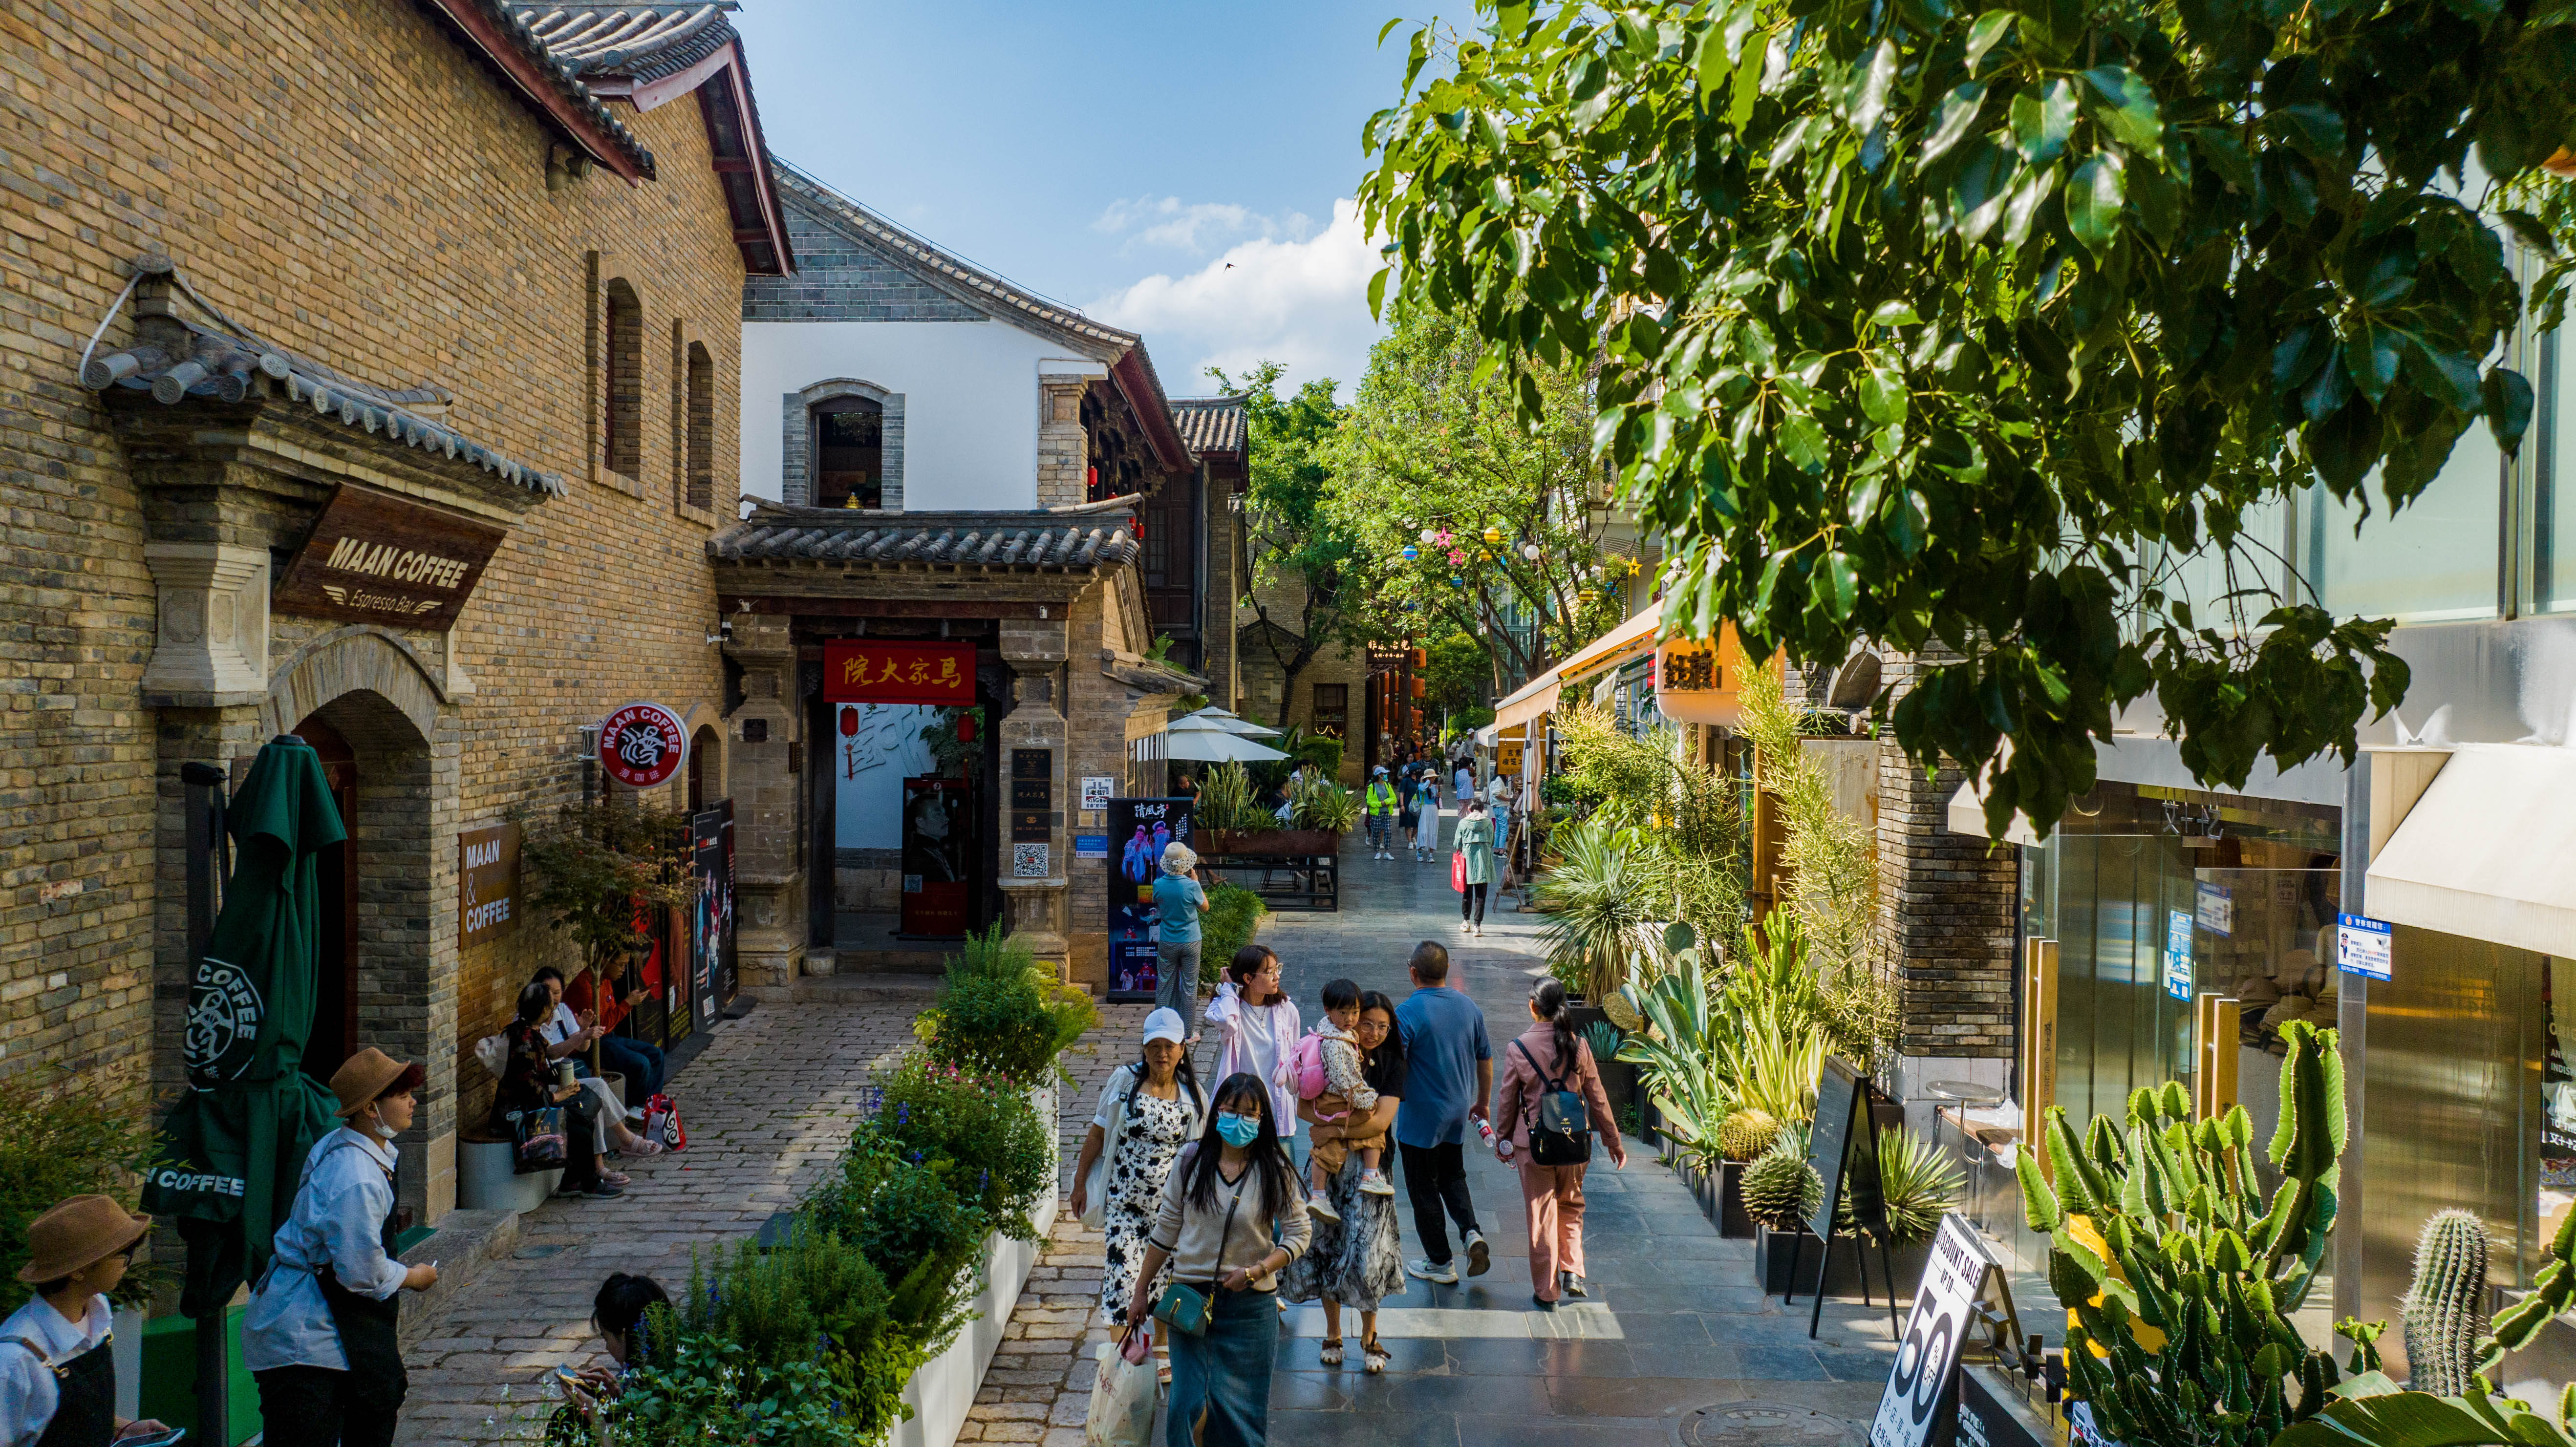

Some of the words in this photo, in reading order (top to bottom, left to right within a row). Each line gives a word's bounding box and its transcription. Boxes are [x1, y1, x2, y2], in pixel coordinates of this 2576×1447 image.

[326, 536, 400, 576] MAAN
[393, 551, 469, 589] COFFEE
[349, 589, 397, 613] Espresso
[397, 594, 415, 614] Bar
[603, 709, 636, 749] MAAN
[640, 708, 680, 755] COFFEE
[619, 767, 660, 783] 漫咖啡
[466, 839, 500, 870] MAAN
[466, 873, 476, 906] &
[465, 897, 510, 934] COFFEE
[196, 964, 258, 1042] COFFEE
[155, 1170, 245, 1196] COFFEE
[1936, 1224, 1964, 1274] DISCOUNT
[1961, 1255, 1981, 1290] SALE
[1940, 1270, 1948, 1286] UP
[1946, 1277, 1954, 1294] TO
[1894, 1285, 1953, 1426] 50
[1932, 1344, 1940, 1363] %
[1923, 1365, 1937, 1388] OFF
